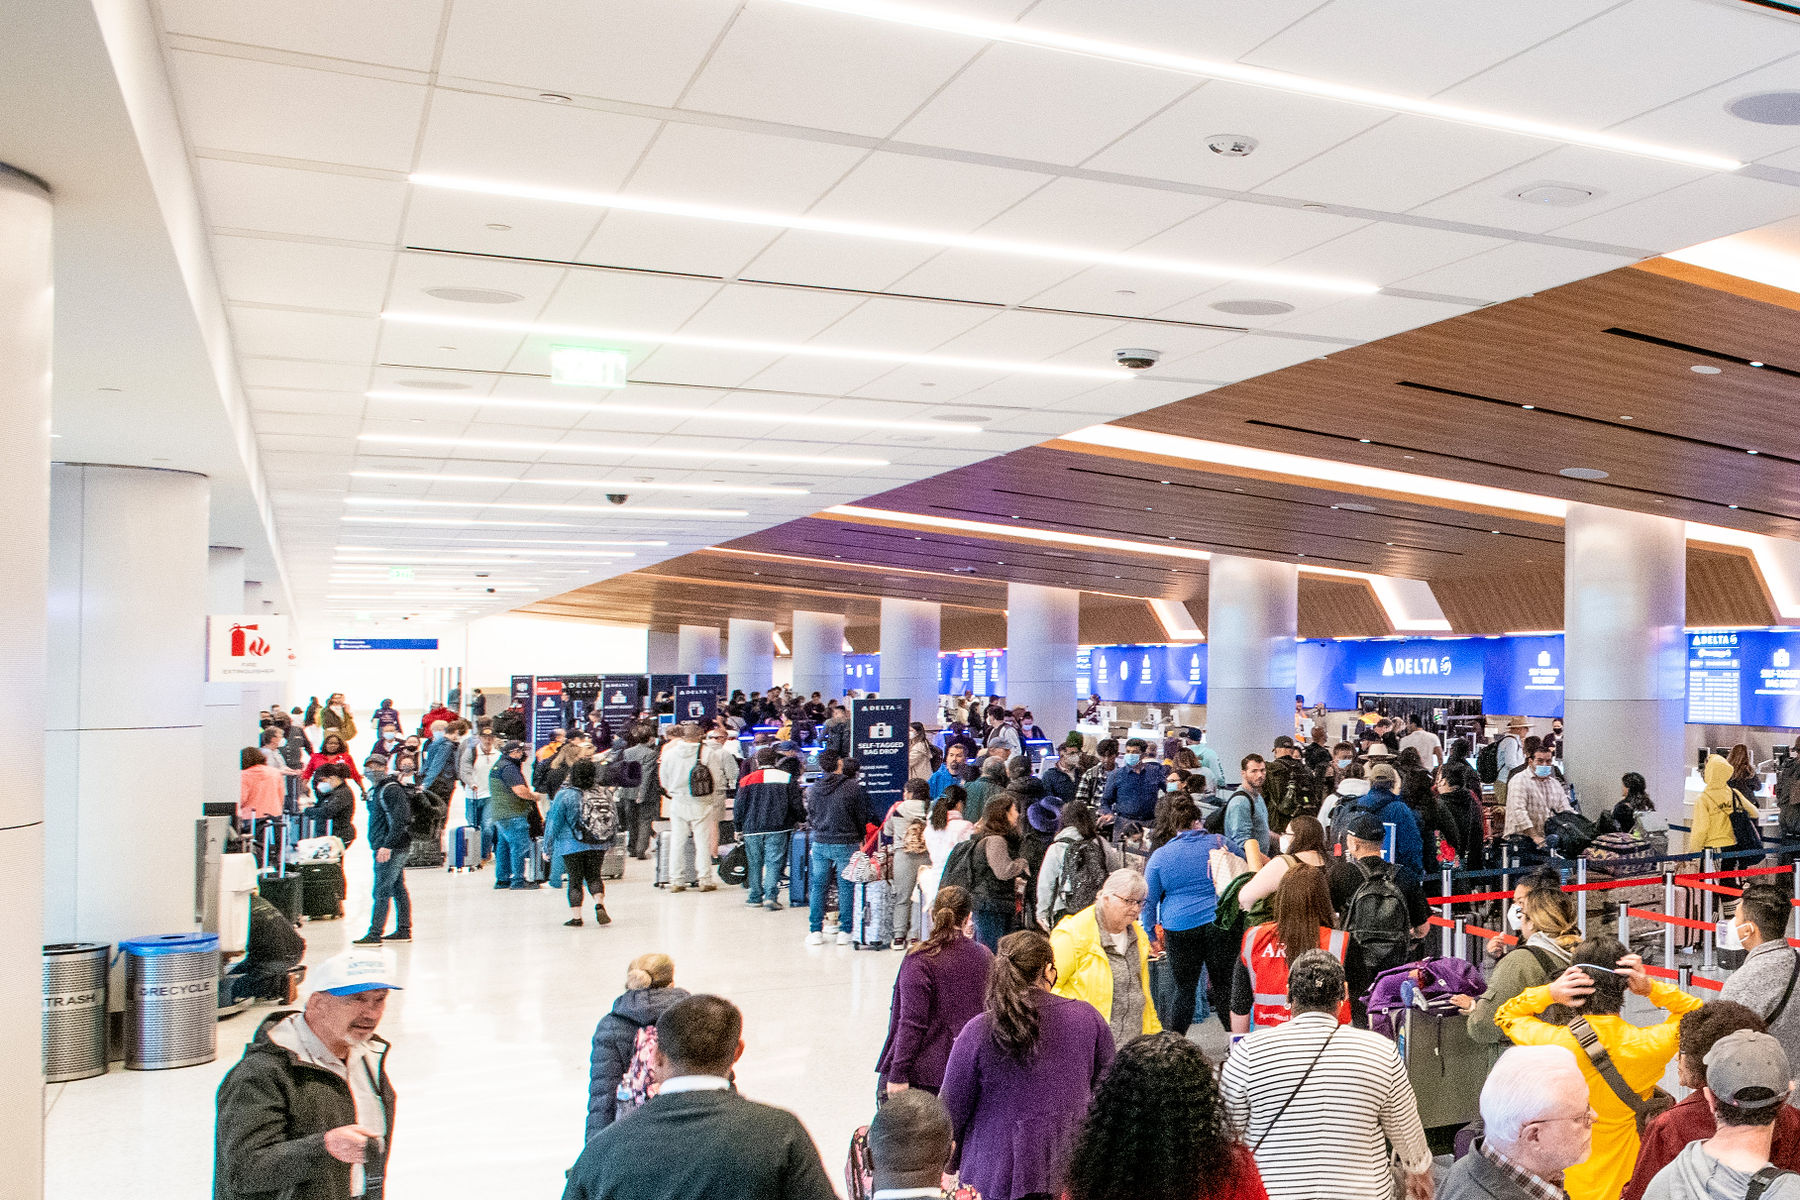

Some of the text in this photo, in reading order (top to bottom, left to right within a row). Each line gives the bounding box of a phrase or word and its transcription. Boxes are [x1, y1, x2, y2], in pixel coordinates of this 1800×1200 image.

[1701, 636, 1729, 644] DELTA
[1395, 658, 1438, 675] DELTA
[149, 982, 210, 997] RECYCLE
[45, 993, 96, 1007] TRASH
